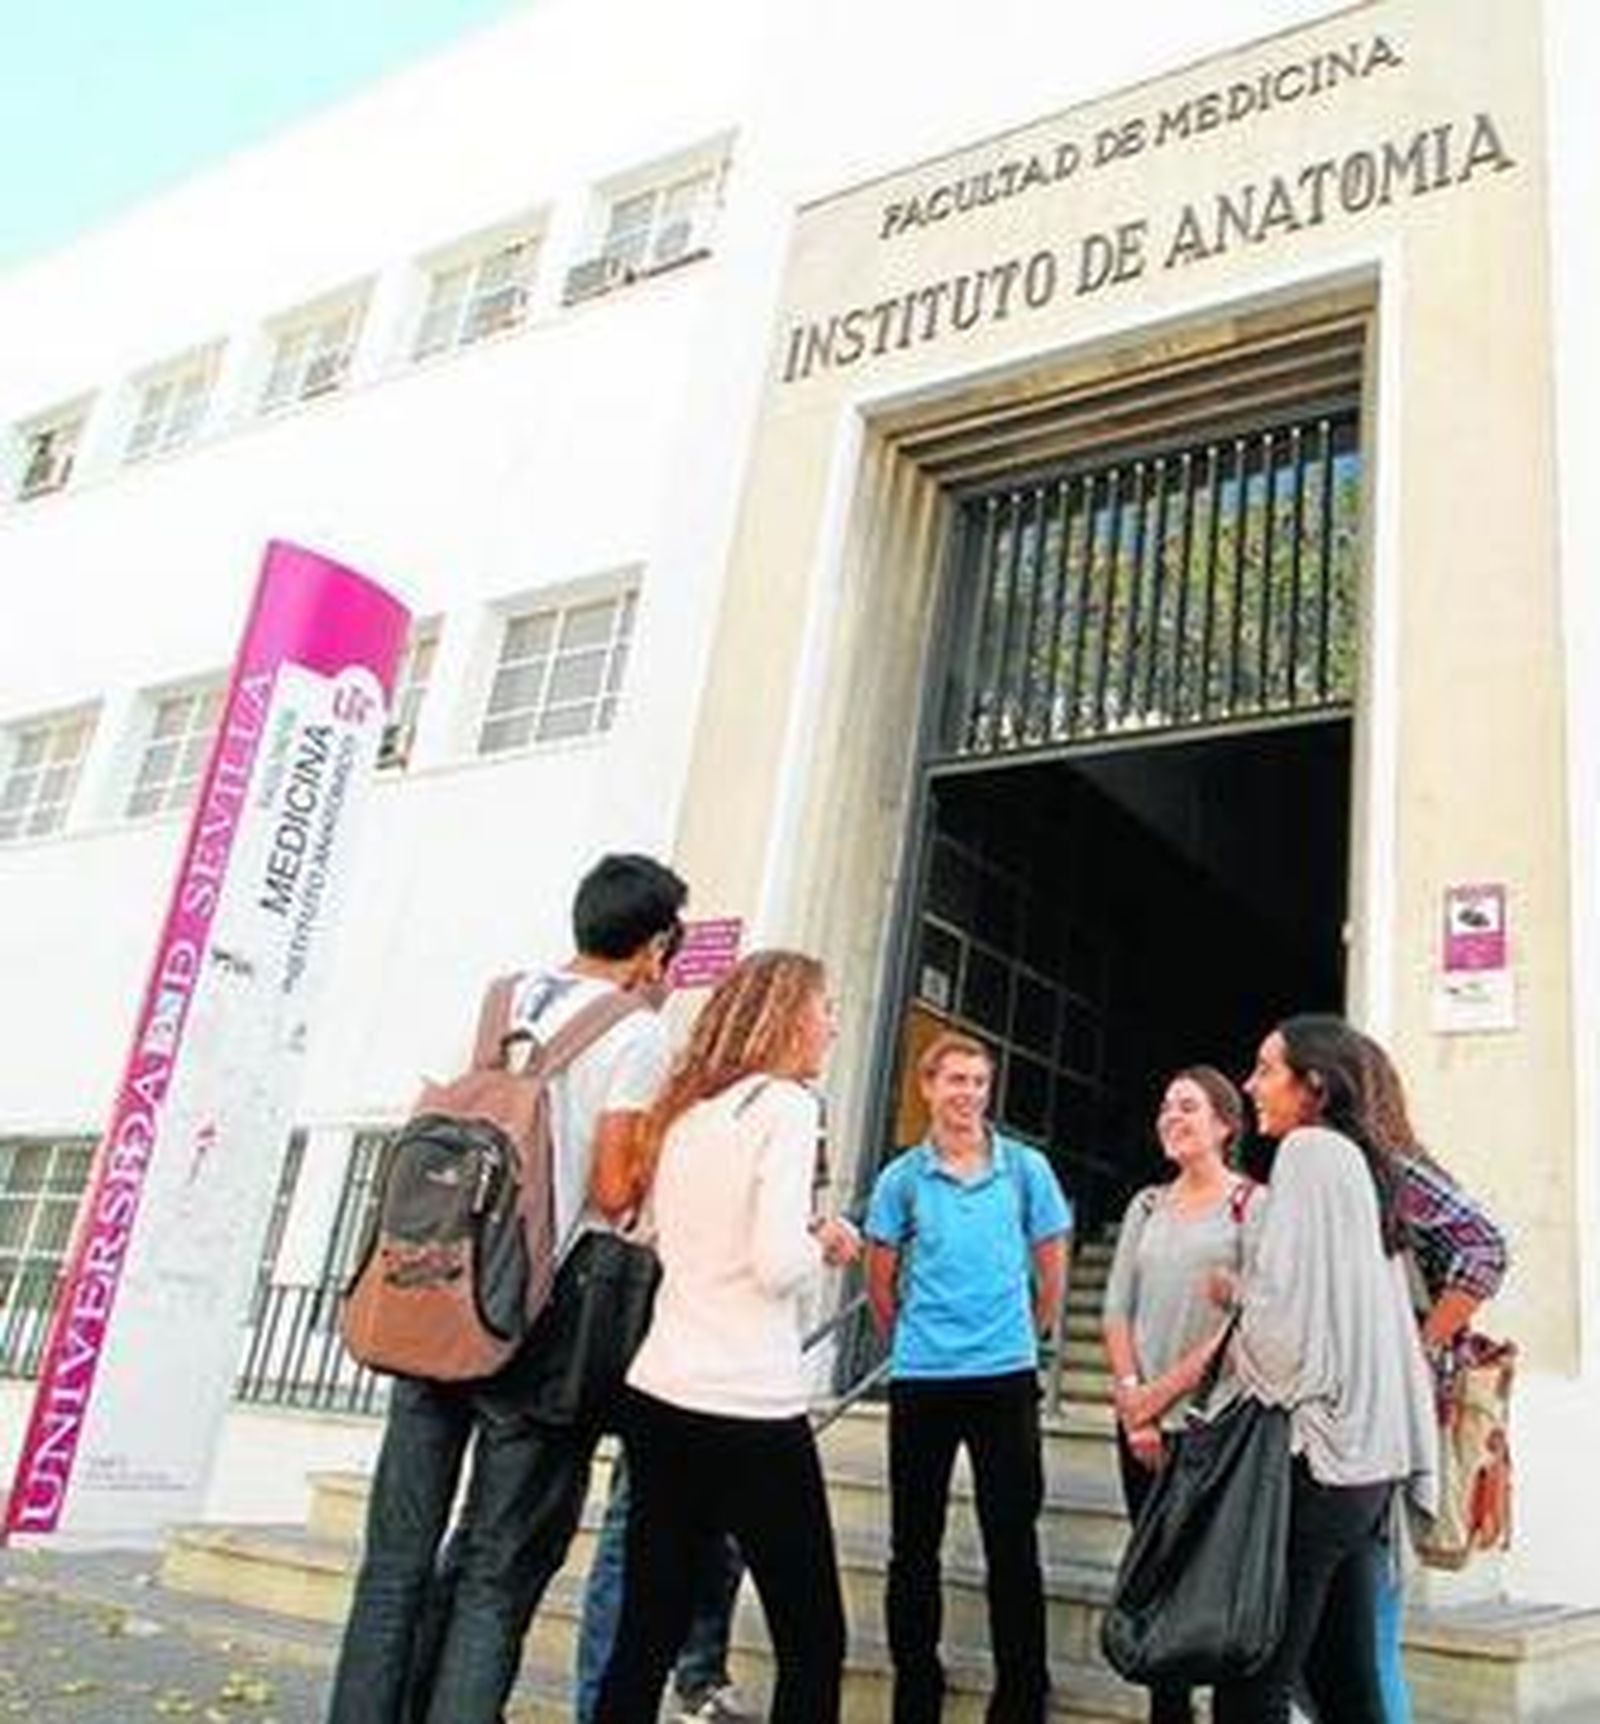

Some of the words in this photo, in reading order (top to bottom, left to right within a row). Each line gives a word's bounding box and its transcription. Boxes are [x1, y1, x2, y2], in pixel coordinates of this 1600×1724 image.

[782, 249, 1057, 382] INSTITUTO
[1075, 219, 1148, 295] DE
[1163, 113, 1516, 269] ANATOMIA
[878, 143, 1082, 239] FACULTAD
[1093, 118, 1147, 168] DE
[1154, 36, 1404, 147] MEDICINA
[178, 670, 274, 920] SEVILLA
[260, 725, 333, 918] MEDICINA
